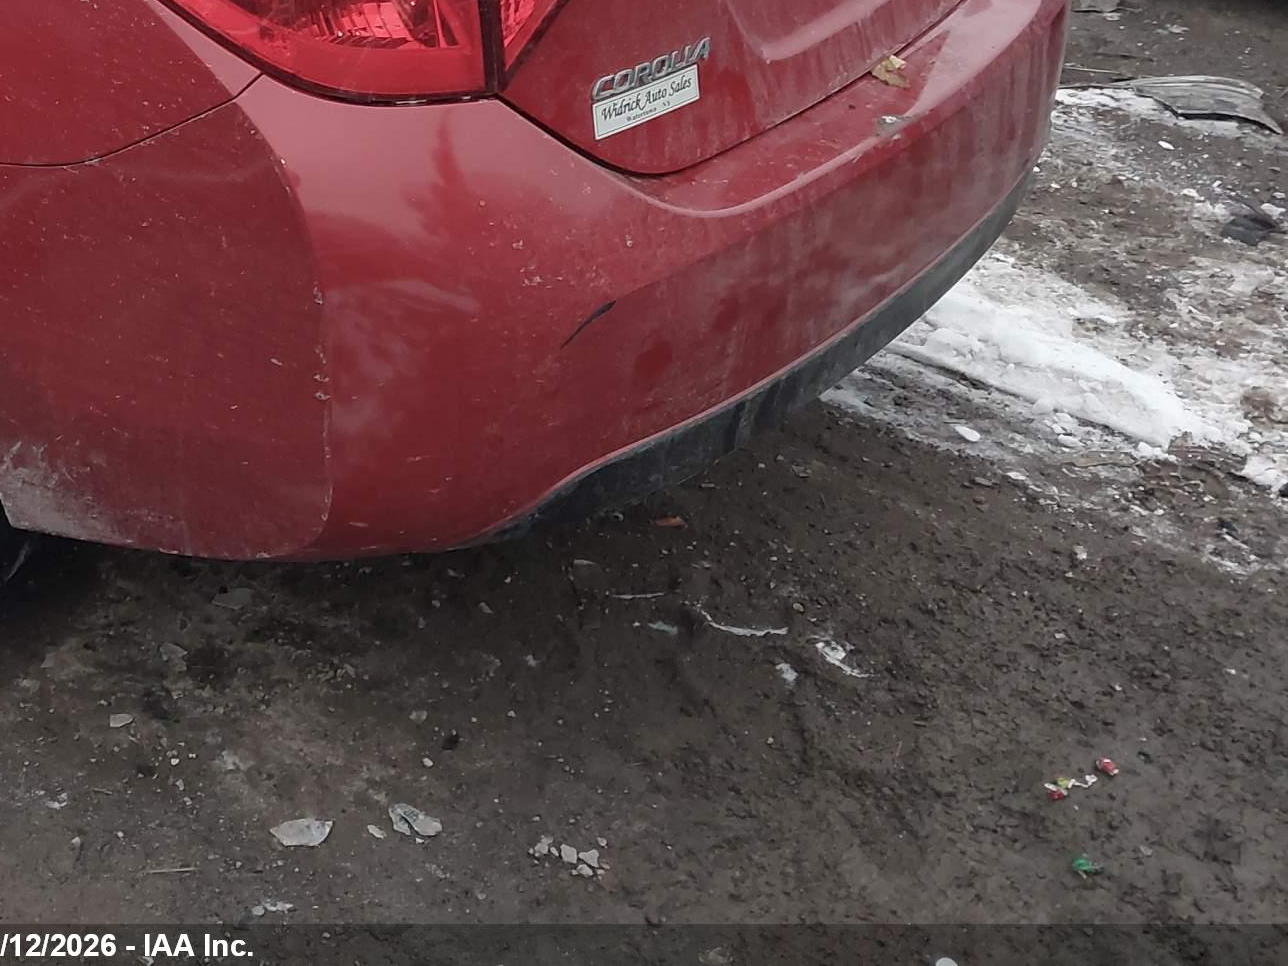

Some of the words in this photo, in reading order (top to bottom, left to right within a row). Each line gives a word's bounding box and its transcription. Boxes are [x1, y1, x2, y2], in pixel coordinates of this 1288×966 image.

[592, 37, 711, 99] COROLLA
[601, 93, 644, 121] Widrick
[643, 88, 668, 108] Auto
[669, 75, 692, 97] Sales
